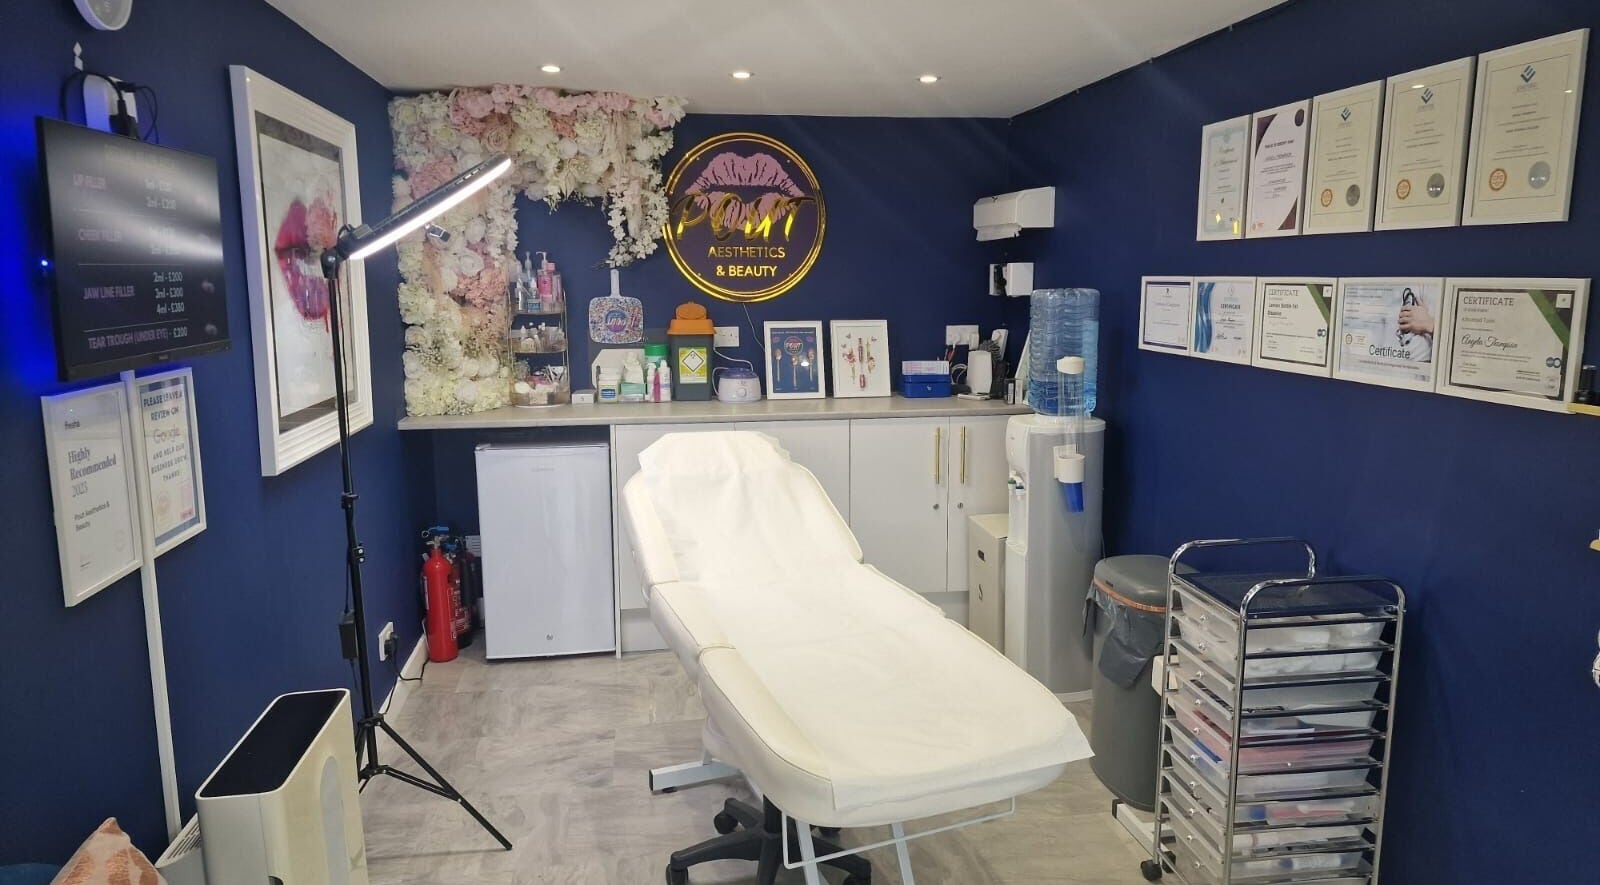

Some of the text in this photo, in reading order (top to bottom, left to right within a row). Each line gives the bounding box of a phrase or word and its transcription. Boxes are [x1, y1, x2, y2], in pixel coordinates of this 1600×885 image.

[707, 246, 786, 258] AESTHETICS
[716, 265, 778, 277] & BEAUTY
[83, 285, 135, 300] JAW LINE FILLER
[1463, 296, 1514, 307] CERTIFICATE
[88, 336, 106, 350] TEAR
[106, 332, 133, 347] TROUGH
[1368, 344, 1412, 360] Certificate
[143, 393, 163, 408] PLEASE
[163, 390, 179, 402] LEAVE
[150, 408, 171, 421] REVIEW
[68, 447, 90, 465] Highly
[69, 453, 116, 480] Recommended
